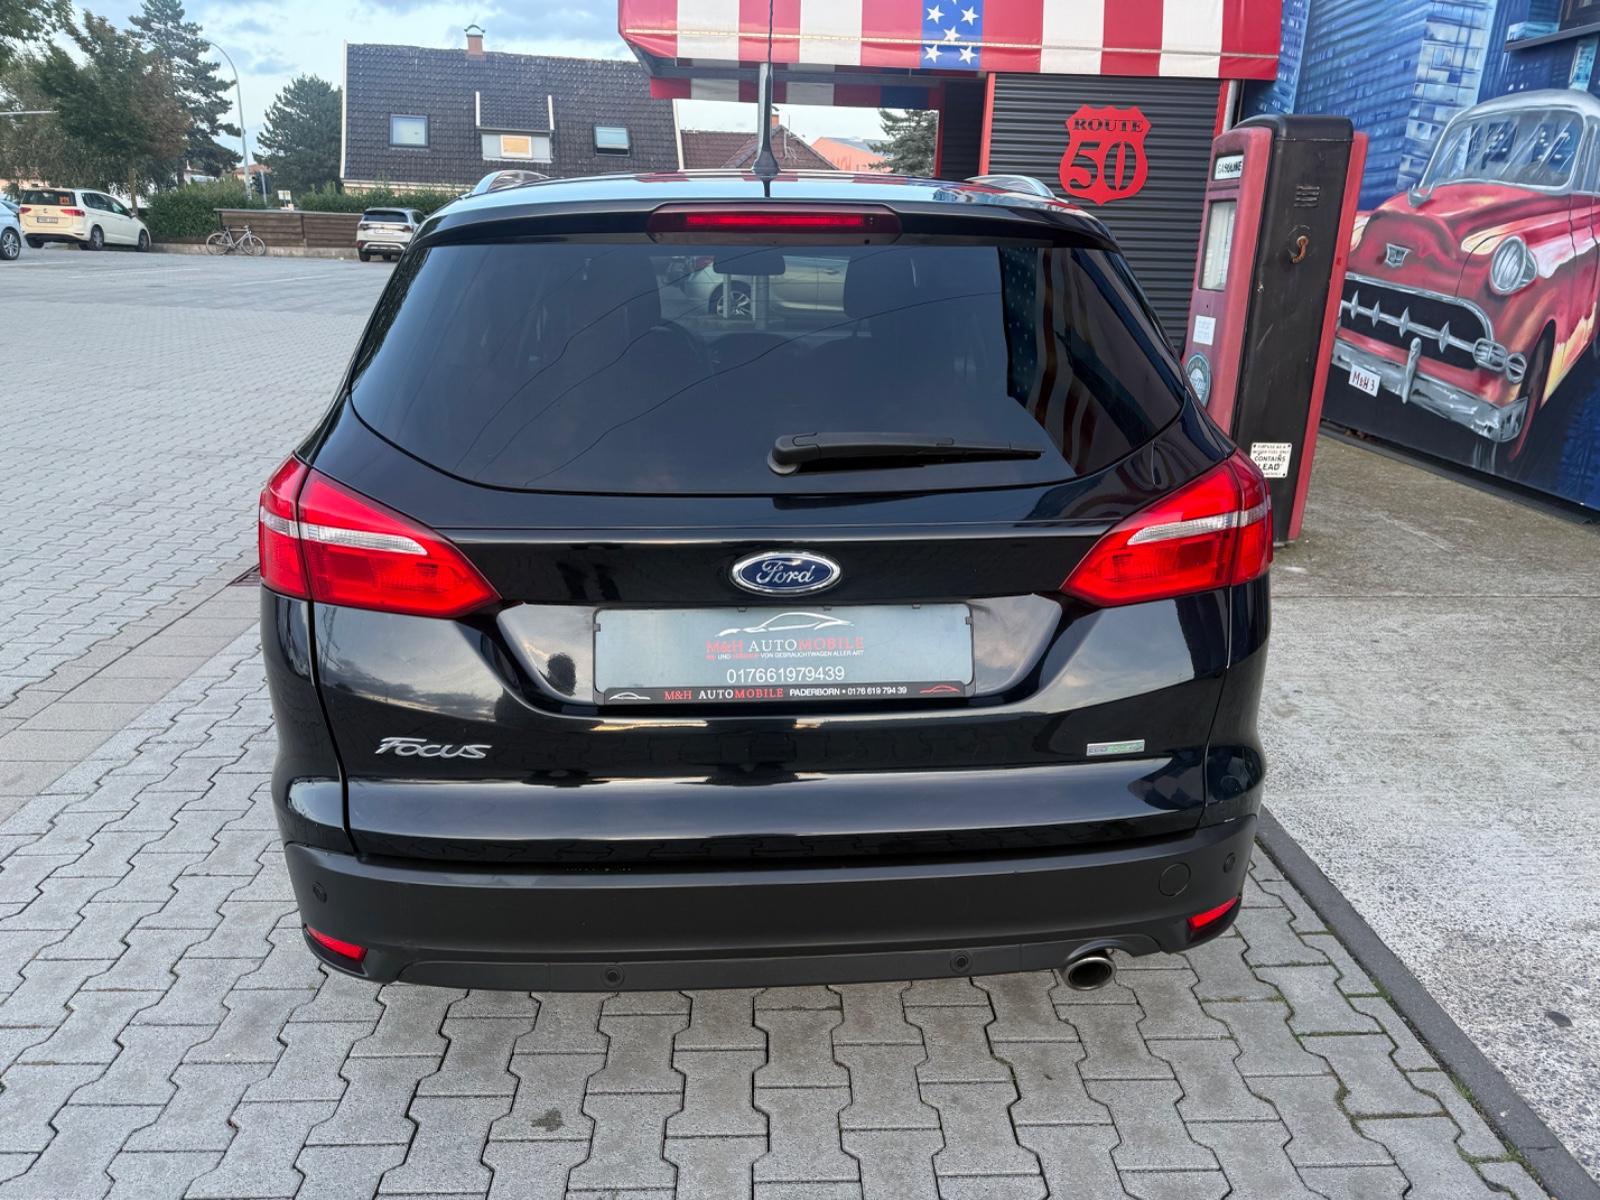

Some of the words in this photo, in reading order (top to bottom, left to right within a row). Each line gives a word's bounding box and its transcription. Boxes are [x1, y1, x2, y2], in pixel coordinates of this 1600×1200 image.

[1073, 118, 1144, 133] ROUTE
[1069, 140, 1137, 191] 50
[756, 560, 816, 584] Ford
[706, 639, 744, 654] M&H
[748, 637, 865, 653] AUTOMOBILE
[833, 649, 851, 657] ALLER
[726, 665, 845, 684] 017661979439
[664, 690, 692, 701] M&H
[698, 687, 784, 700] AUTOMOBILE
[789, 687, 840, 697] PADERBORN
[847, 687, 866, 696] 0176
[882, 687, 896, 695] 794
